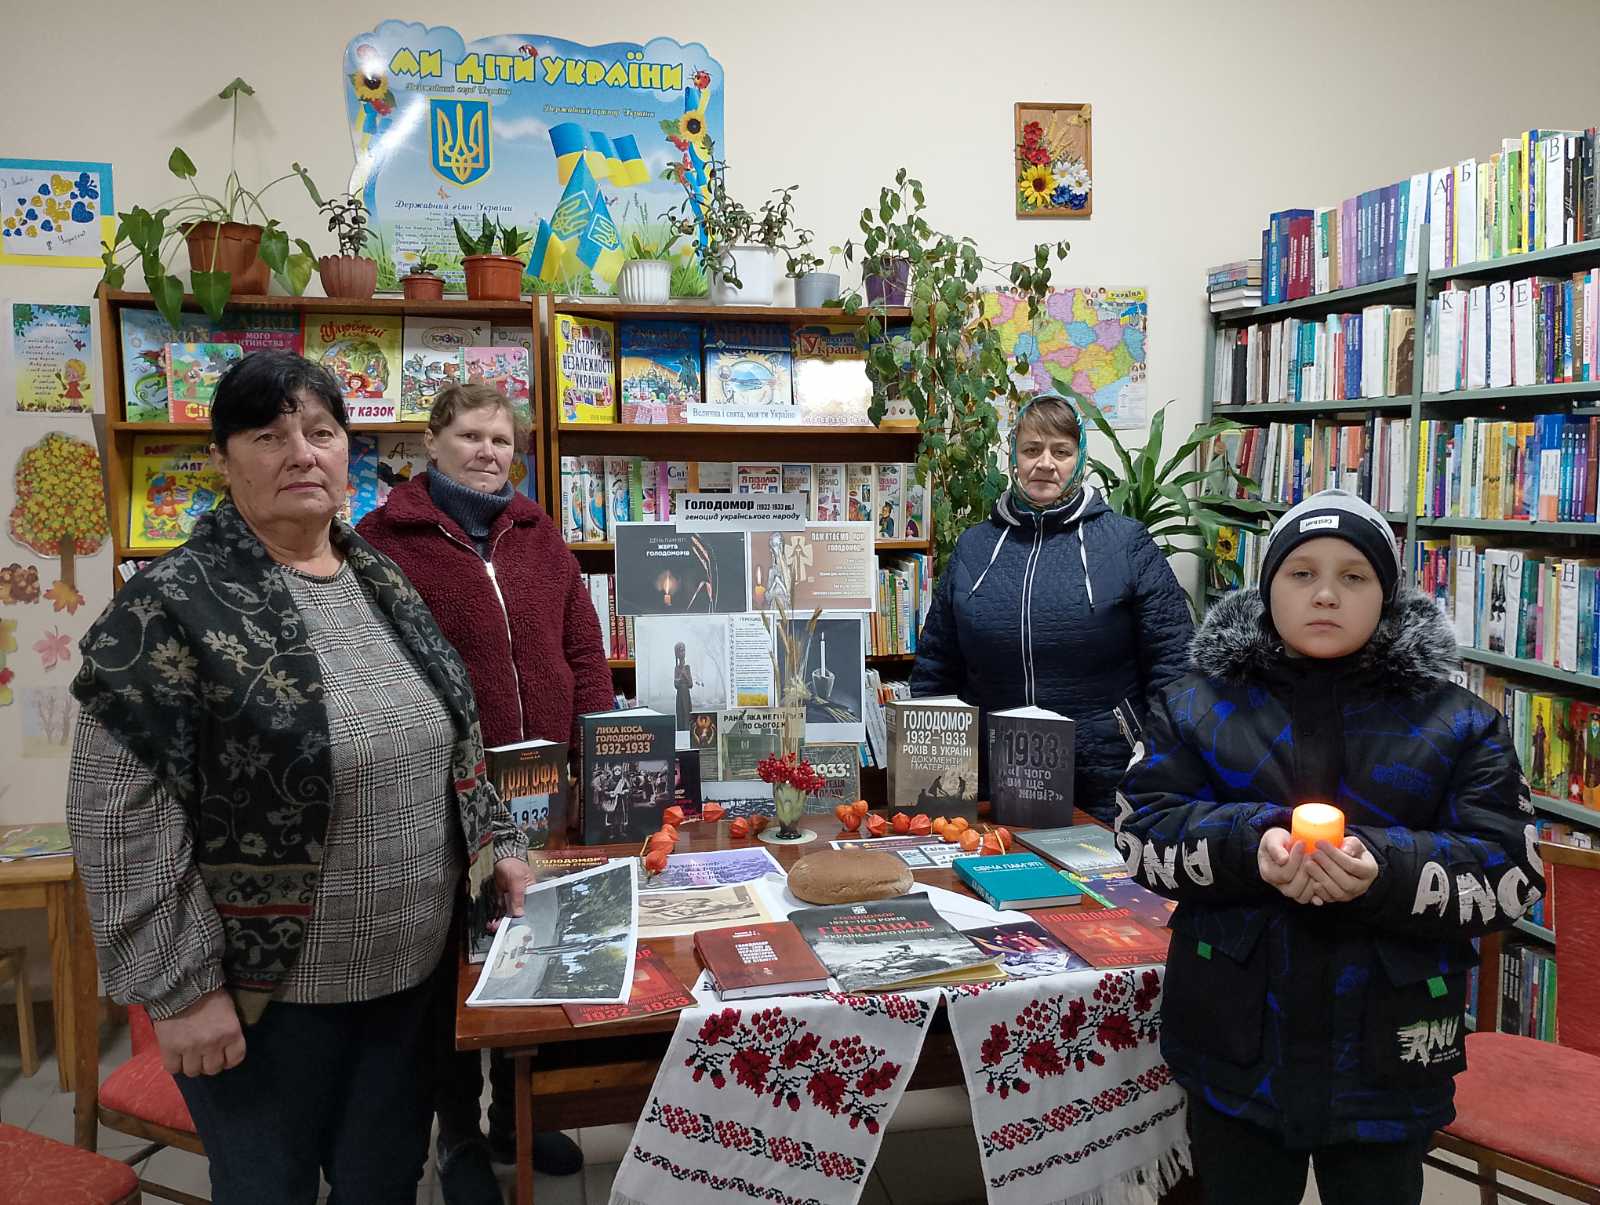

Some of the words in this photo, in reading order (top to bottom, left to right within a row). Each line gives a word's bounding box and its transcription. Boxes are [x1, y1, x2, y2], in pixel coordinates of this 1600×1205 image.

[389, 48, 442, 79] МИ
[455, 53, 536, 84] ДІТИ
[540, 51, 683, 91] УКРАЇНИ
[1550, 137, 1560, 158] В
[1461, 163, 1471, 182] Б
[1434, 177, 1448, 196] А
[394, 200, 449, 212] Державний
[1442, 292, 1453, 311] К
[1496, 284, 1506, 303] З
[1517, 283, 1529, 303] Е
[685, 499, 754, 511] Голодомор
[720, 512, 770, 521] українського
[772, 512, 800, 521] народу
[1458, 550, 1471, 568] П
[1509, 554, 1520, 572] О
[1563, 564, 1575, 582] Н
[903, 710, 973, 733] ГОЛОДОМОР
[595, 726, 619, 735] ЛИХА
[620, 725, 643, 733] КОСА
[595, 742, 651, 755] 1932-1933
[903, 745, 928, 755] РОКІВ
[931, 745, 938, 755] В
[940, 745, 972, 757] УКРАЇНІ
[1003, 729, 1059, 769] 1933
[911, 755, 962, 764] ДОКУМЕНТИ
[1024, 768, 1052, 780] чого
[1025, 779, 1044, 790] ще
[1018, 789, 1064, 801] живі?»
[818, 920, 934, 935] ГЕНОЦИД
